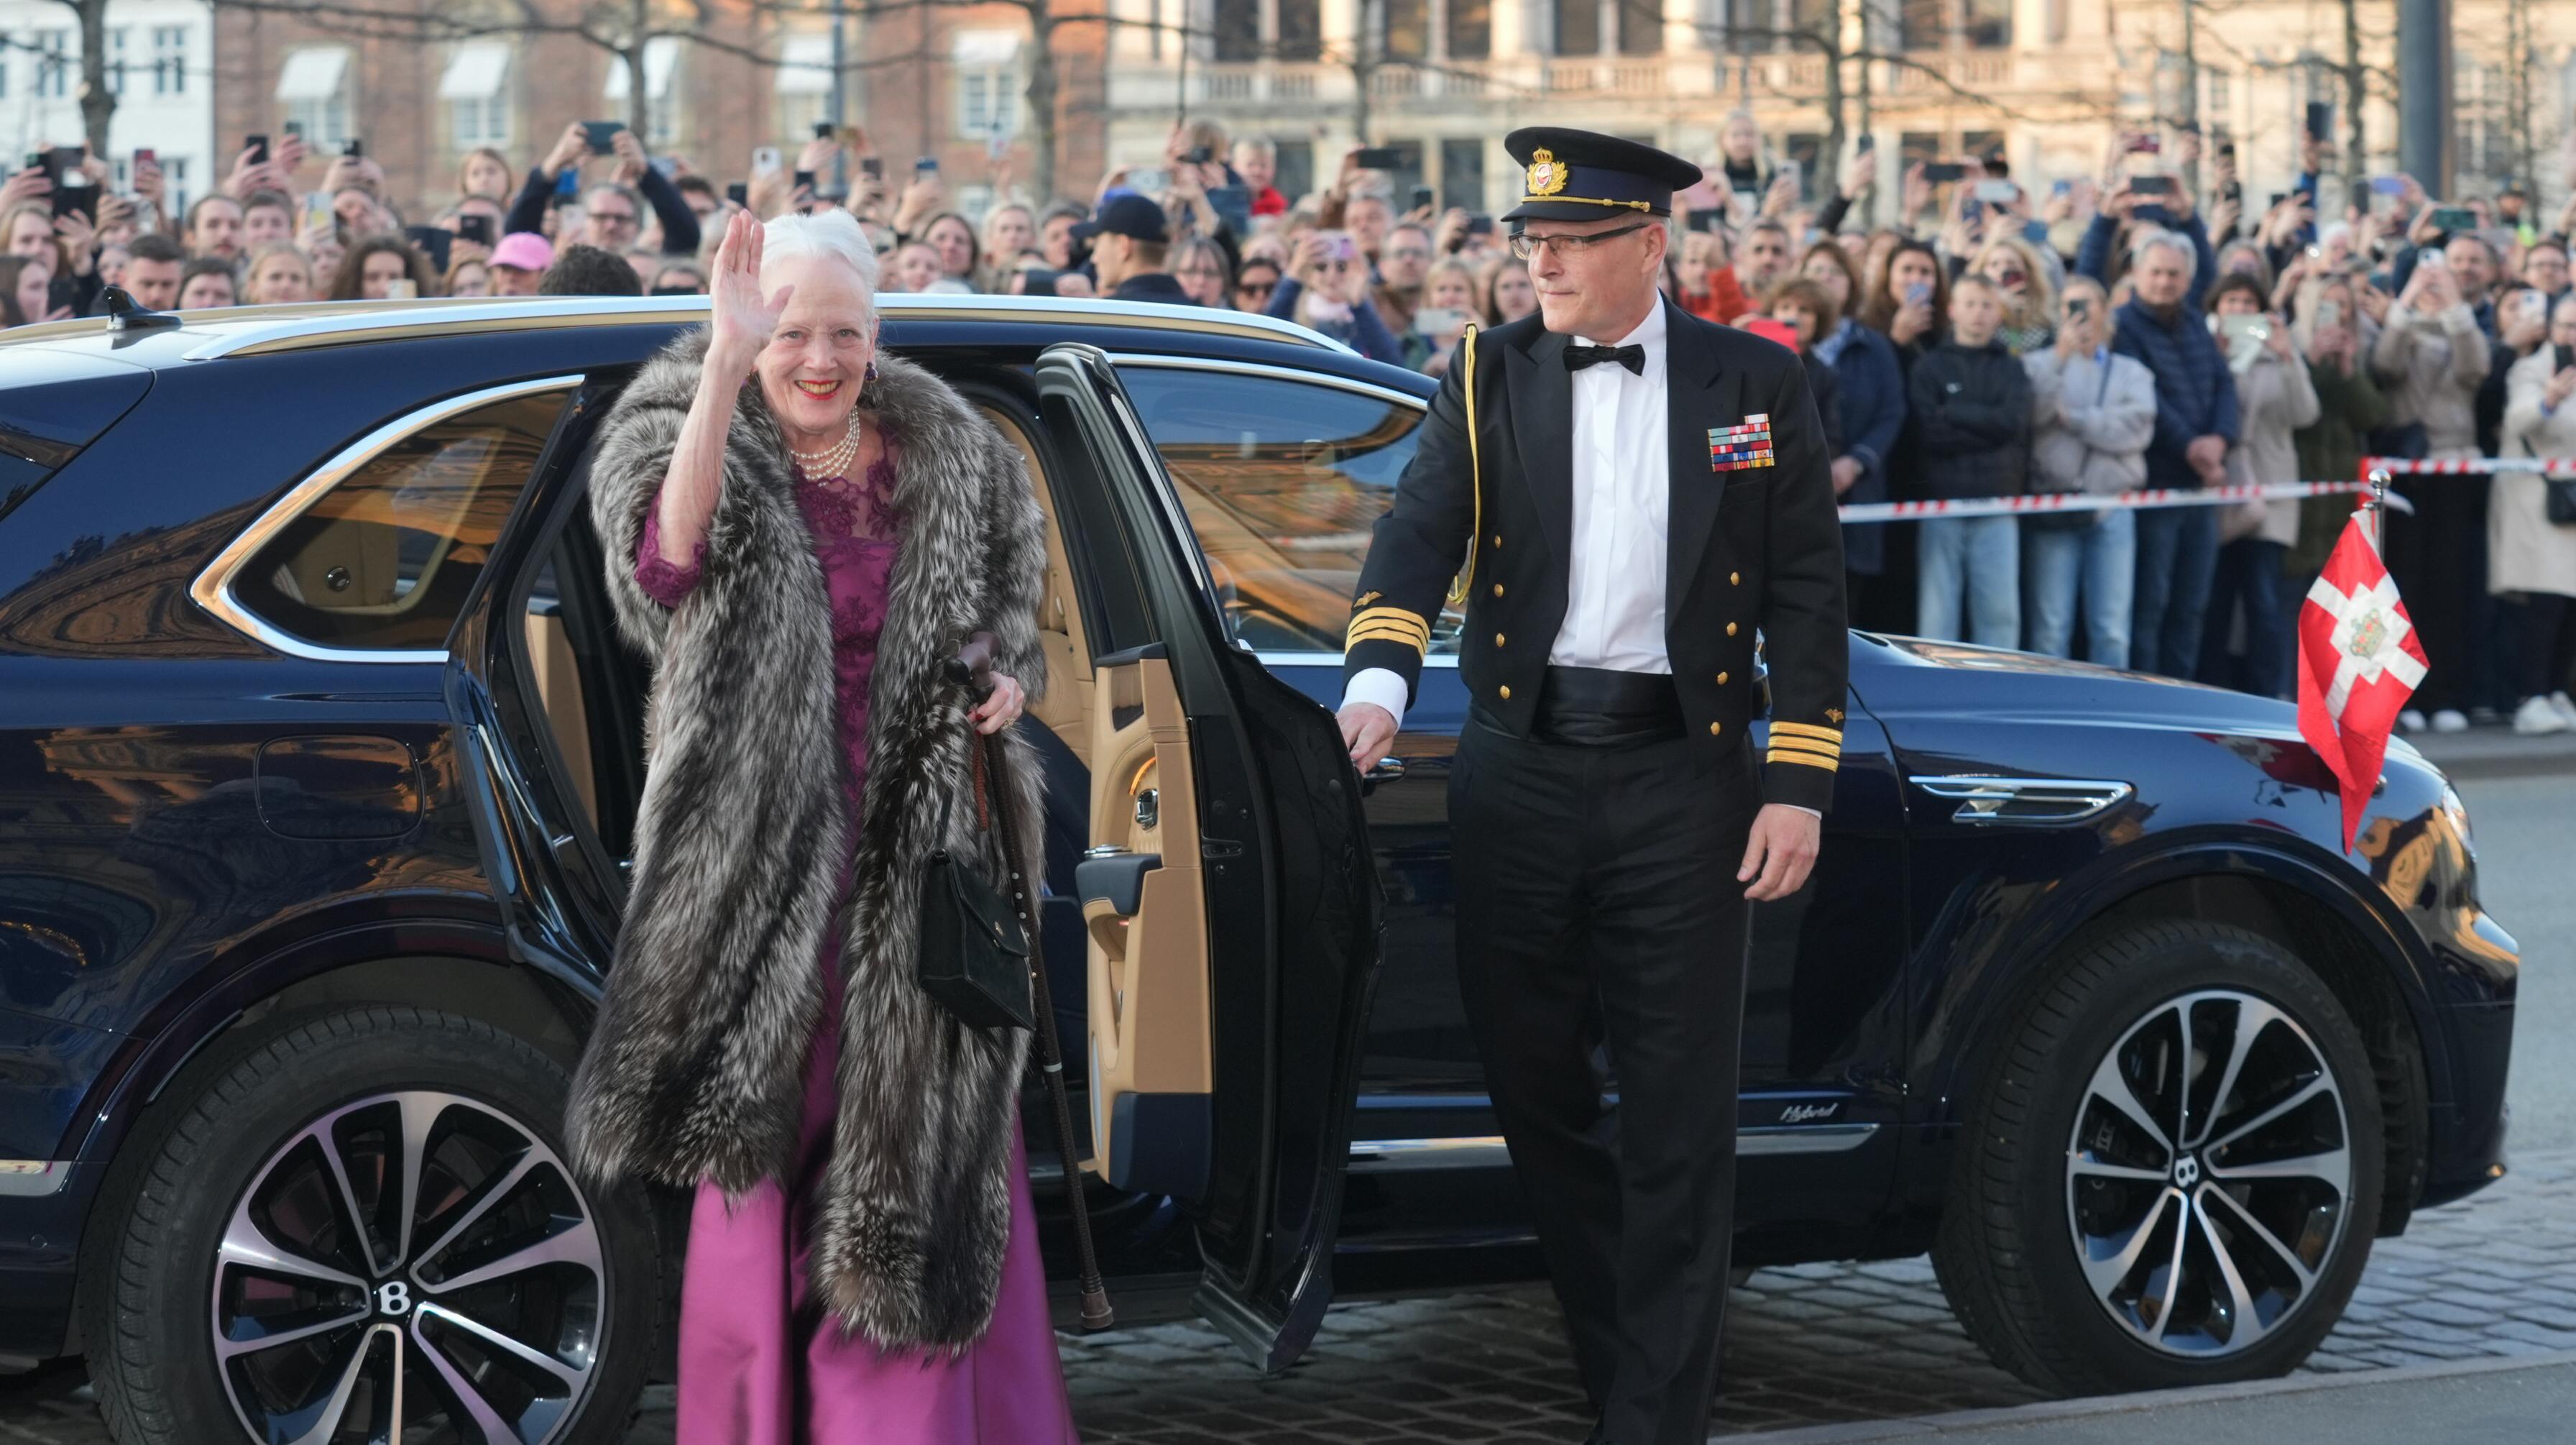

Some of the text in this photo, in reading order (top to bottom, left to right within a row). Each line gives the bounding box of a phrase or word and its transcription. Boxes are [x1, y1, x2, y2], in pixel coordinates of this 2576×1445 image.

[1779, 1102, 1839, 1123] Hybrid
[2174, 1155, 2199, 1188] B
[378, 1280, 411, 1315] B
